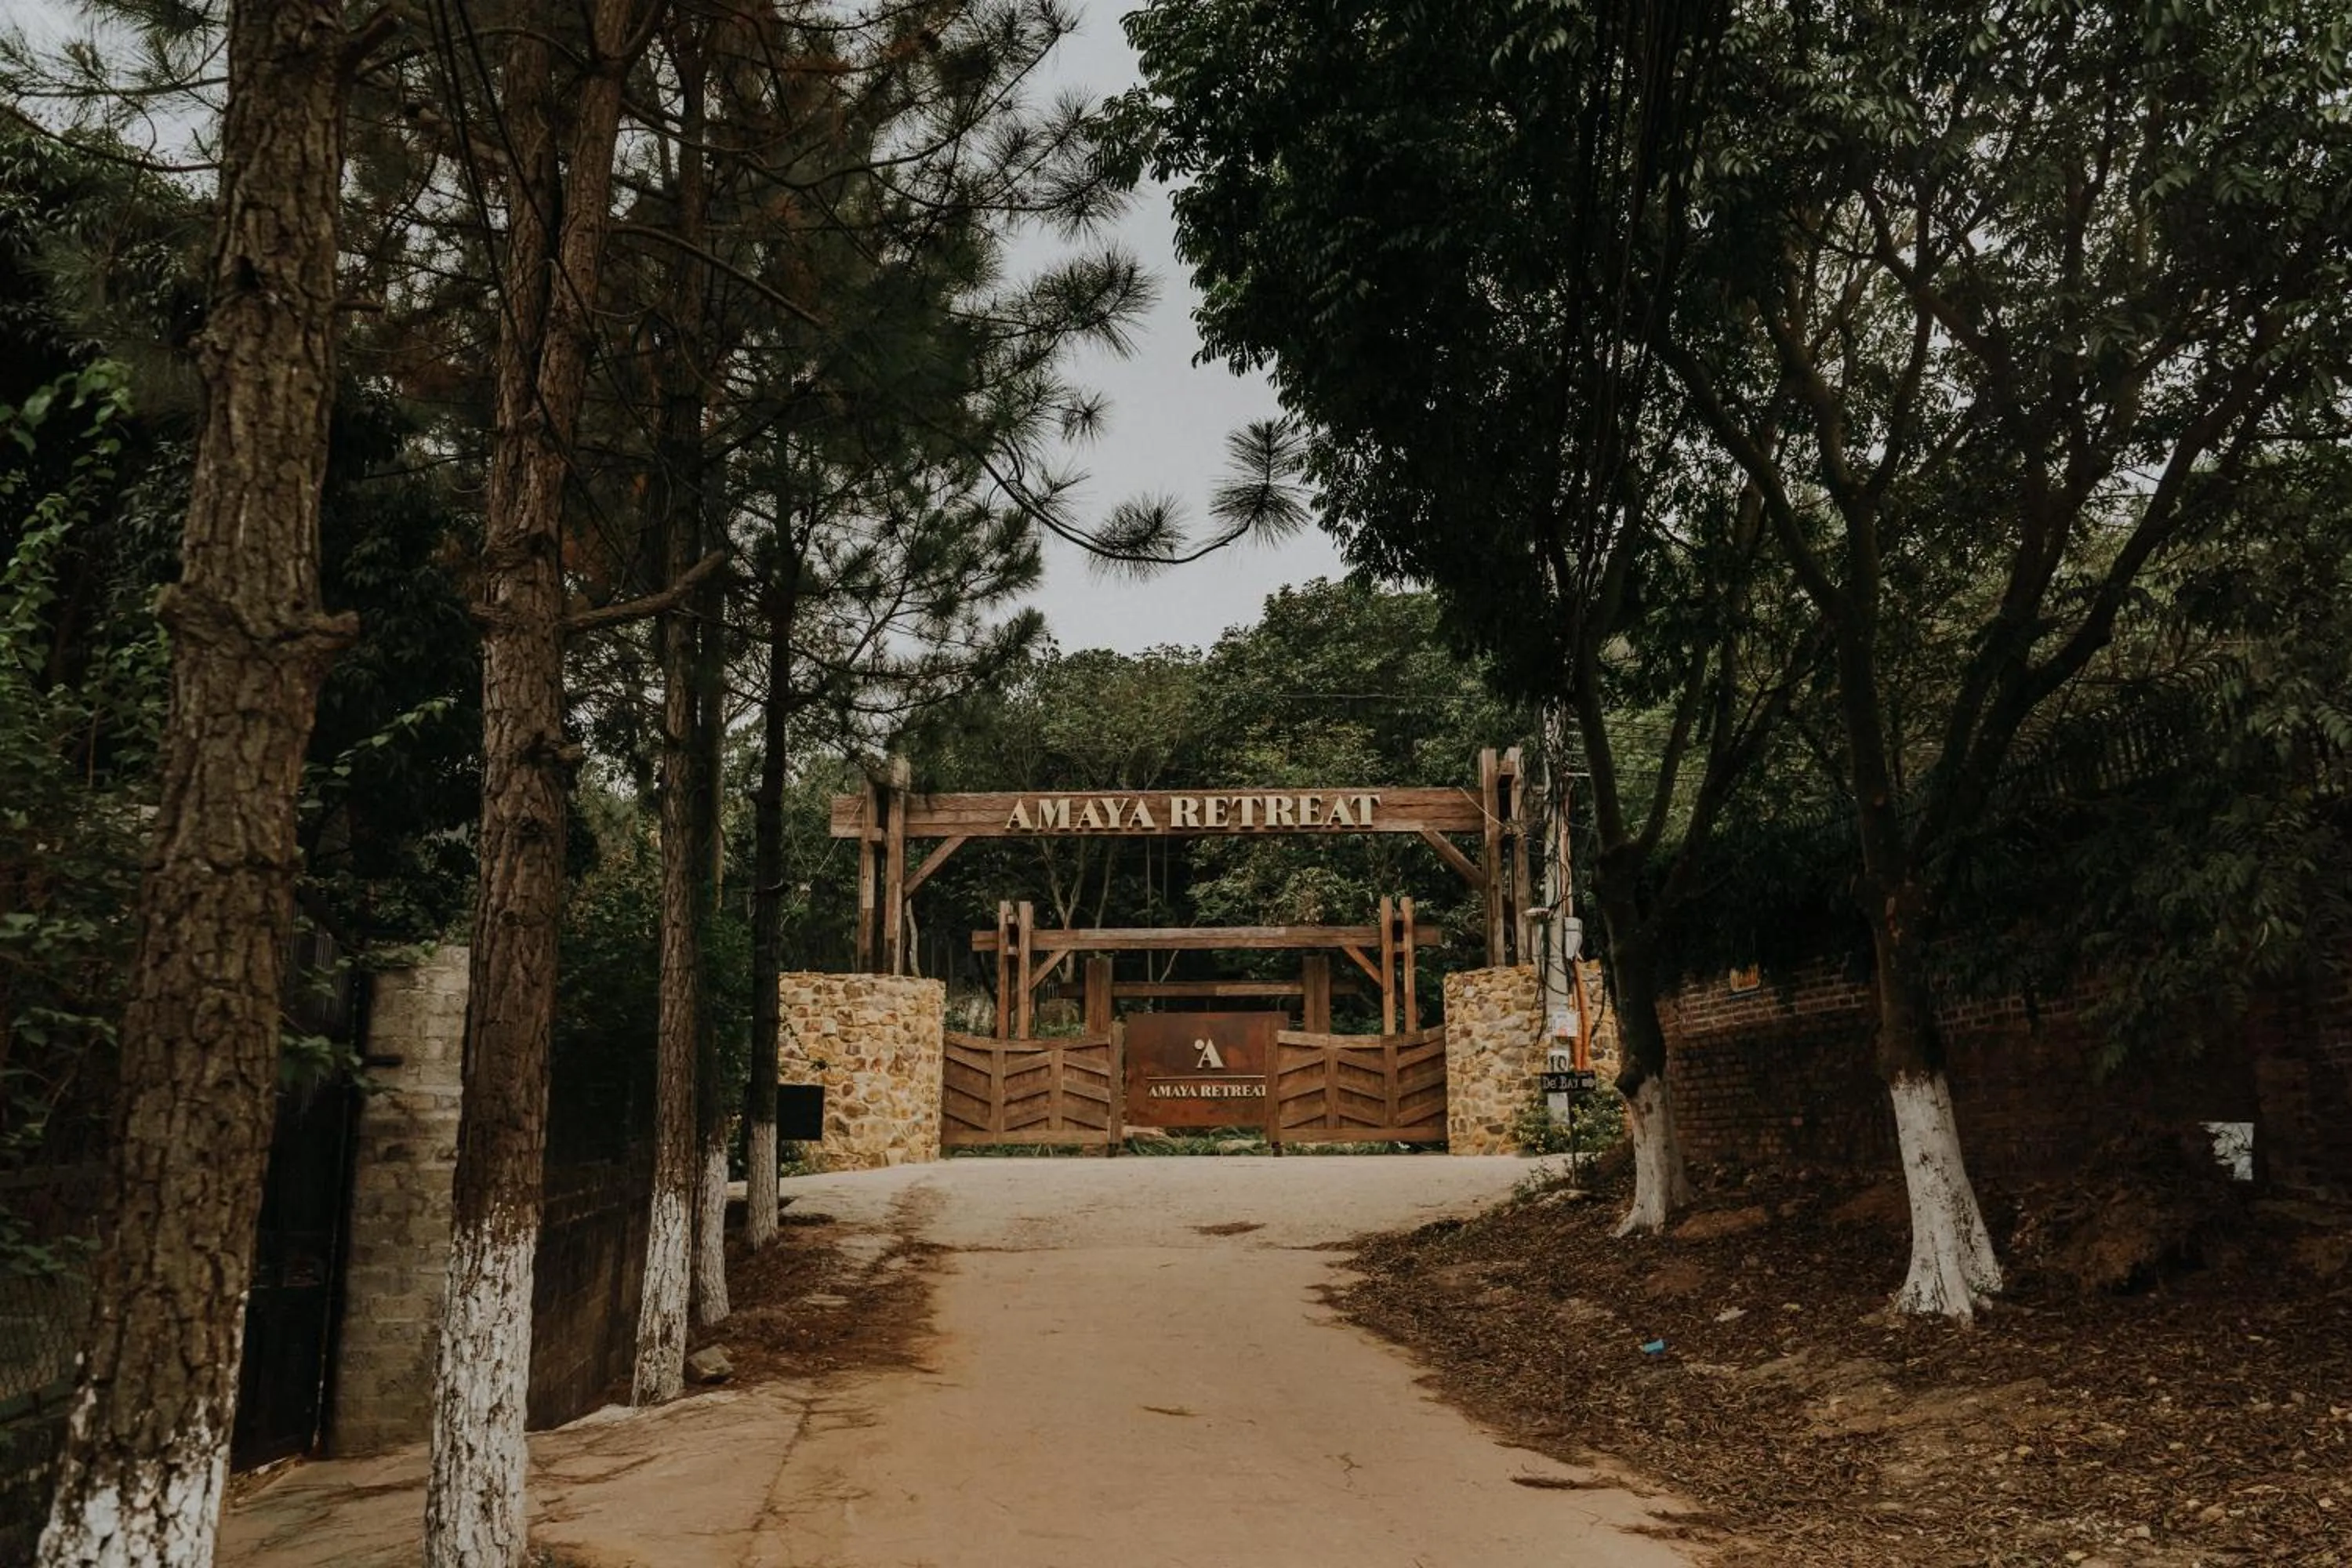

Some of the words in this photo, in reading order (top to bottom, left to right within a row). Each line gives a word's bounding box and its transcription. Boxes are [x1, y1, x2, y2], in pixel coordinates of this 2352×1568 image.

[1005, 797, 1156, 829] AMAYA
[1170, 794, 1381, 828] RETREAT
[1149, 1084, 1196, 1098] AMAYA
